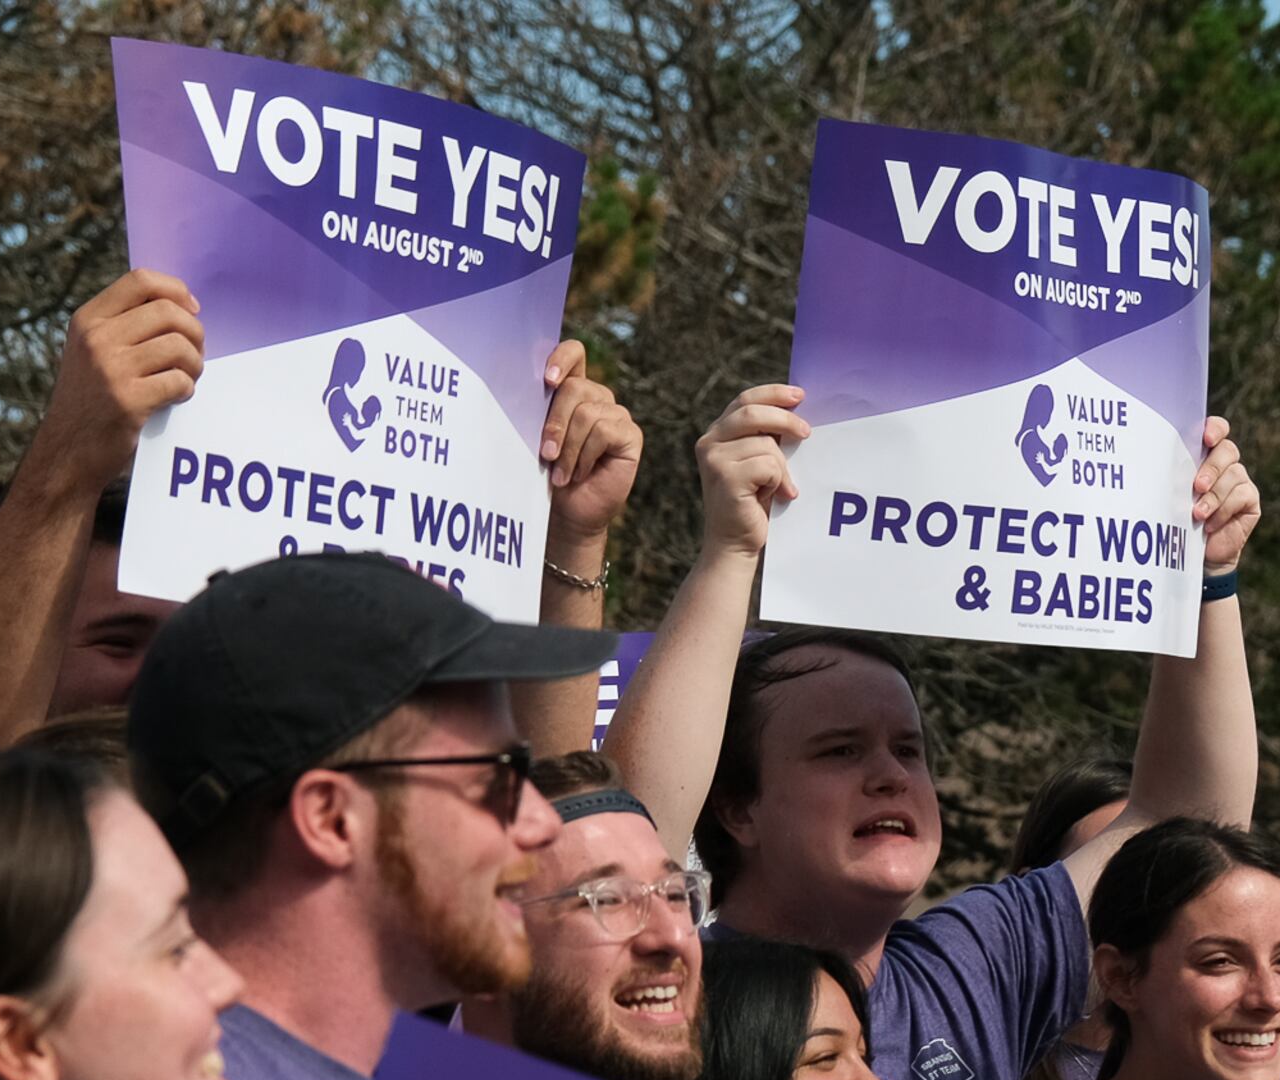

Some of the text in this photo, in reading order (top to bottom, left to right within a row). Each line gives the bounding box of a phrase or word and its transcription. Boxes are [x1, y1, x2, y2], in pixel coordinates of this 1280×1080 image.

[183, 80, 560, 259] VOTE YES!
[322, 210, 484, 273] ON AUGUST 2ND
[884, 159, 1200, 289] VOTE YES!
[1014, 272, 1142, 313] ON AUGUST 2ND
[384, 352, 460, 398] VALUE
[396, 396, 444, 426] THEM
[1067, 394, 1128, 427] VALUE
[384, 426, 450, 467] BOTH
[1077, 430, 1116, 454] THEM
[1072, 458, 1124, 490] BOTH
[169, 446, 524, 569] PROTECT WOMEN
[828, 490, 1187, 572] PROTECT WOMEN
[955, 565, 1153, 624] & BABIES
